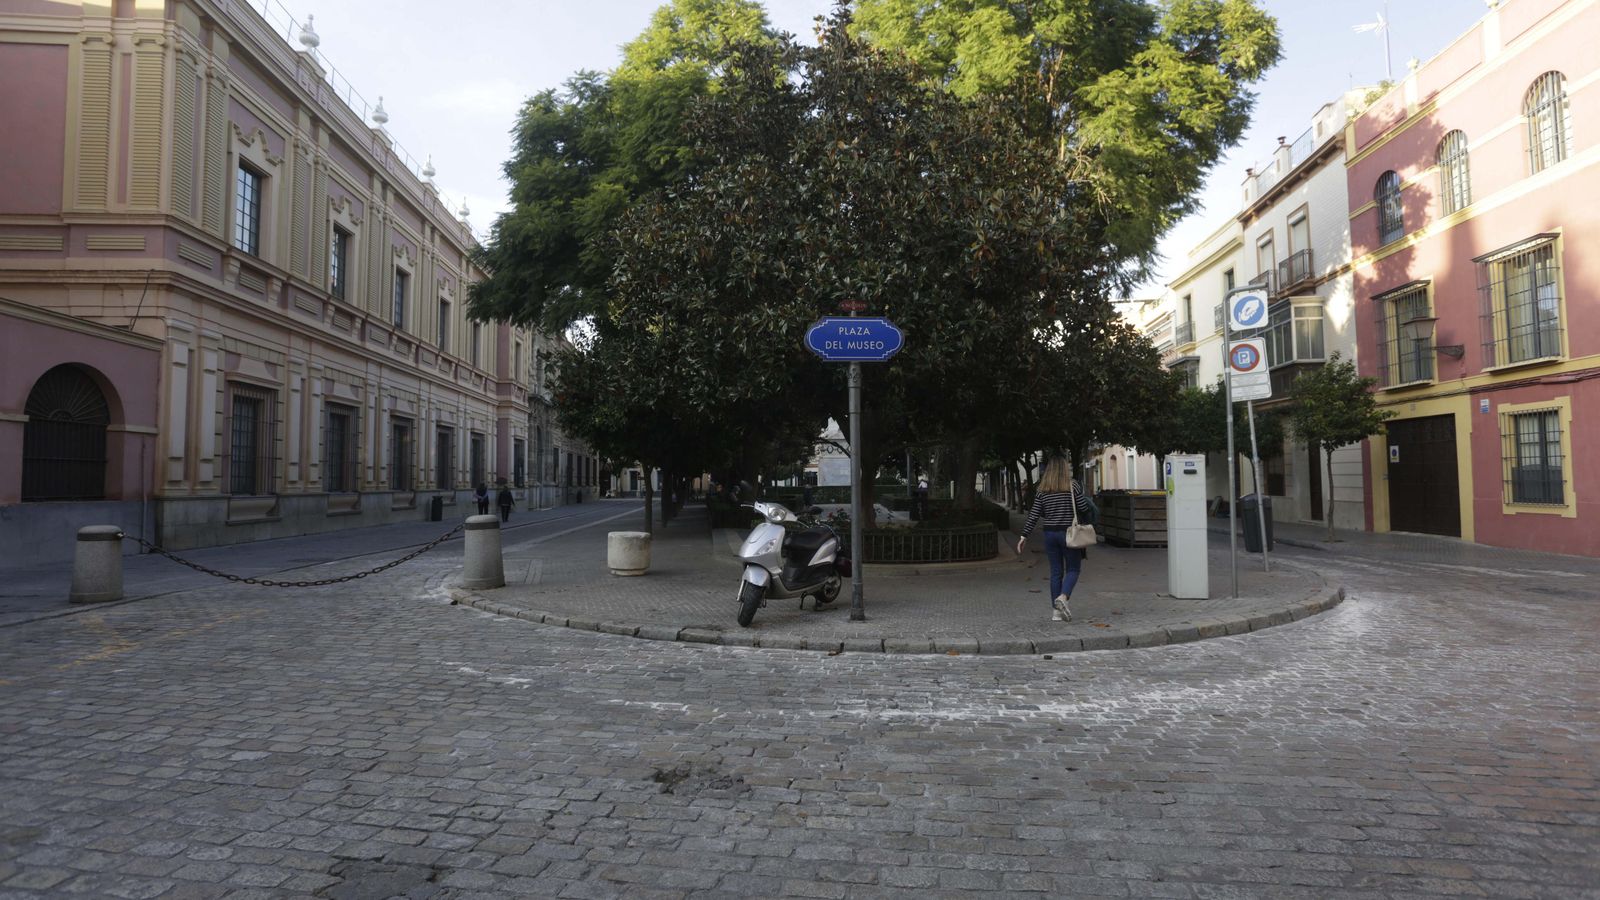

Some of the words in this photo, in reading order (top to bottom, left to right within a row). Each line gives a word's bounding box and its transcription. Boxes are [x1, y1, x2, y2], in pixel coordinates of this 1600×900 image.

[838, 327, 871, 335] PLAZA
[825, 341, 843, 349] DEL
[847, 341, 884, 349] MUSEO
[1239, 352, 1248, 363] P
